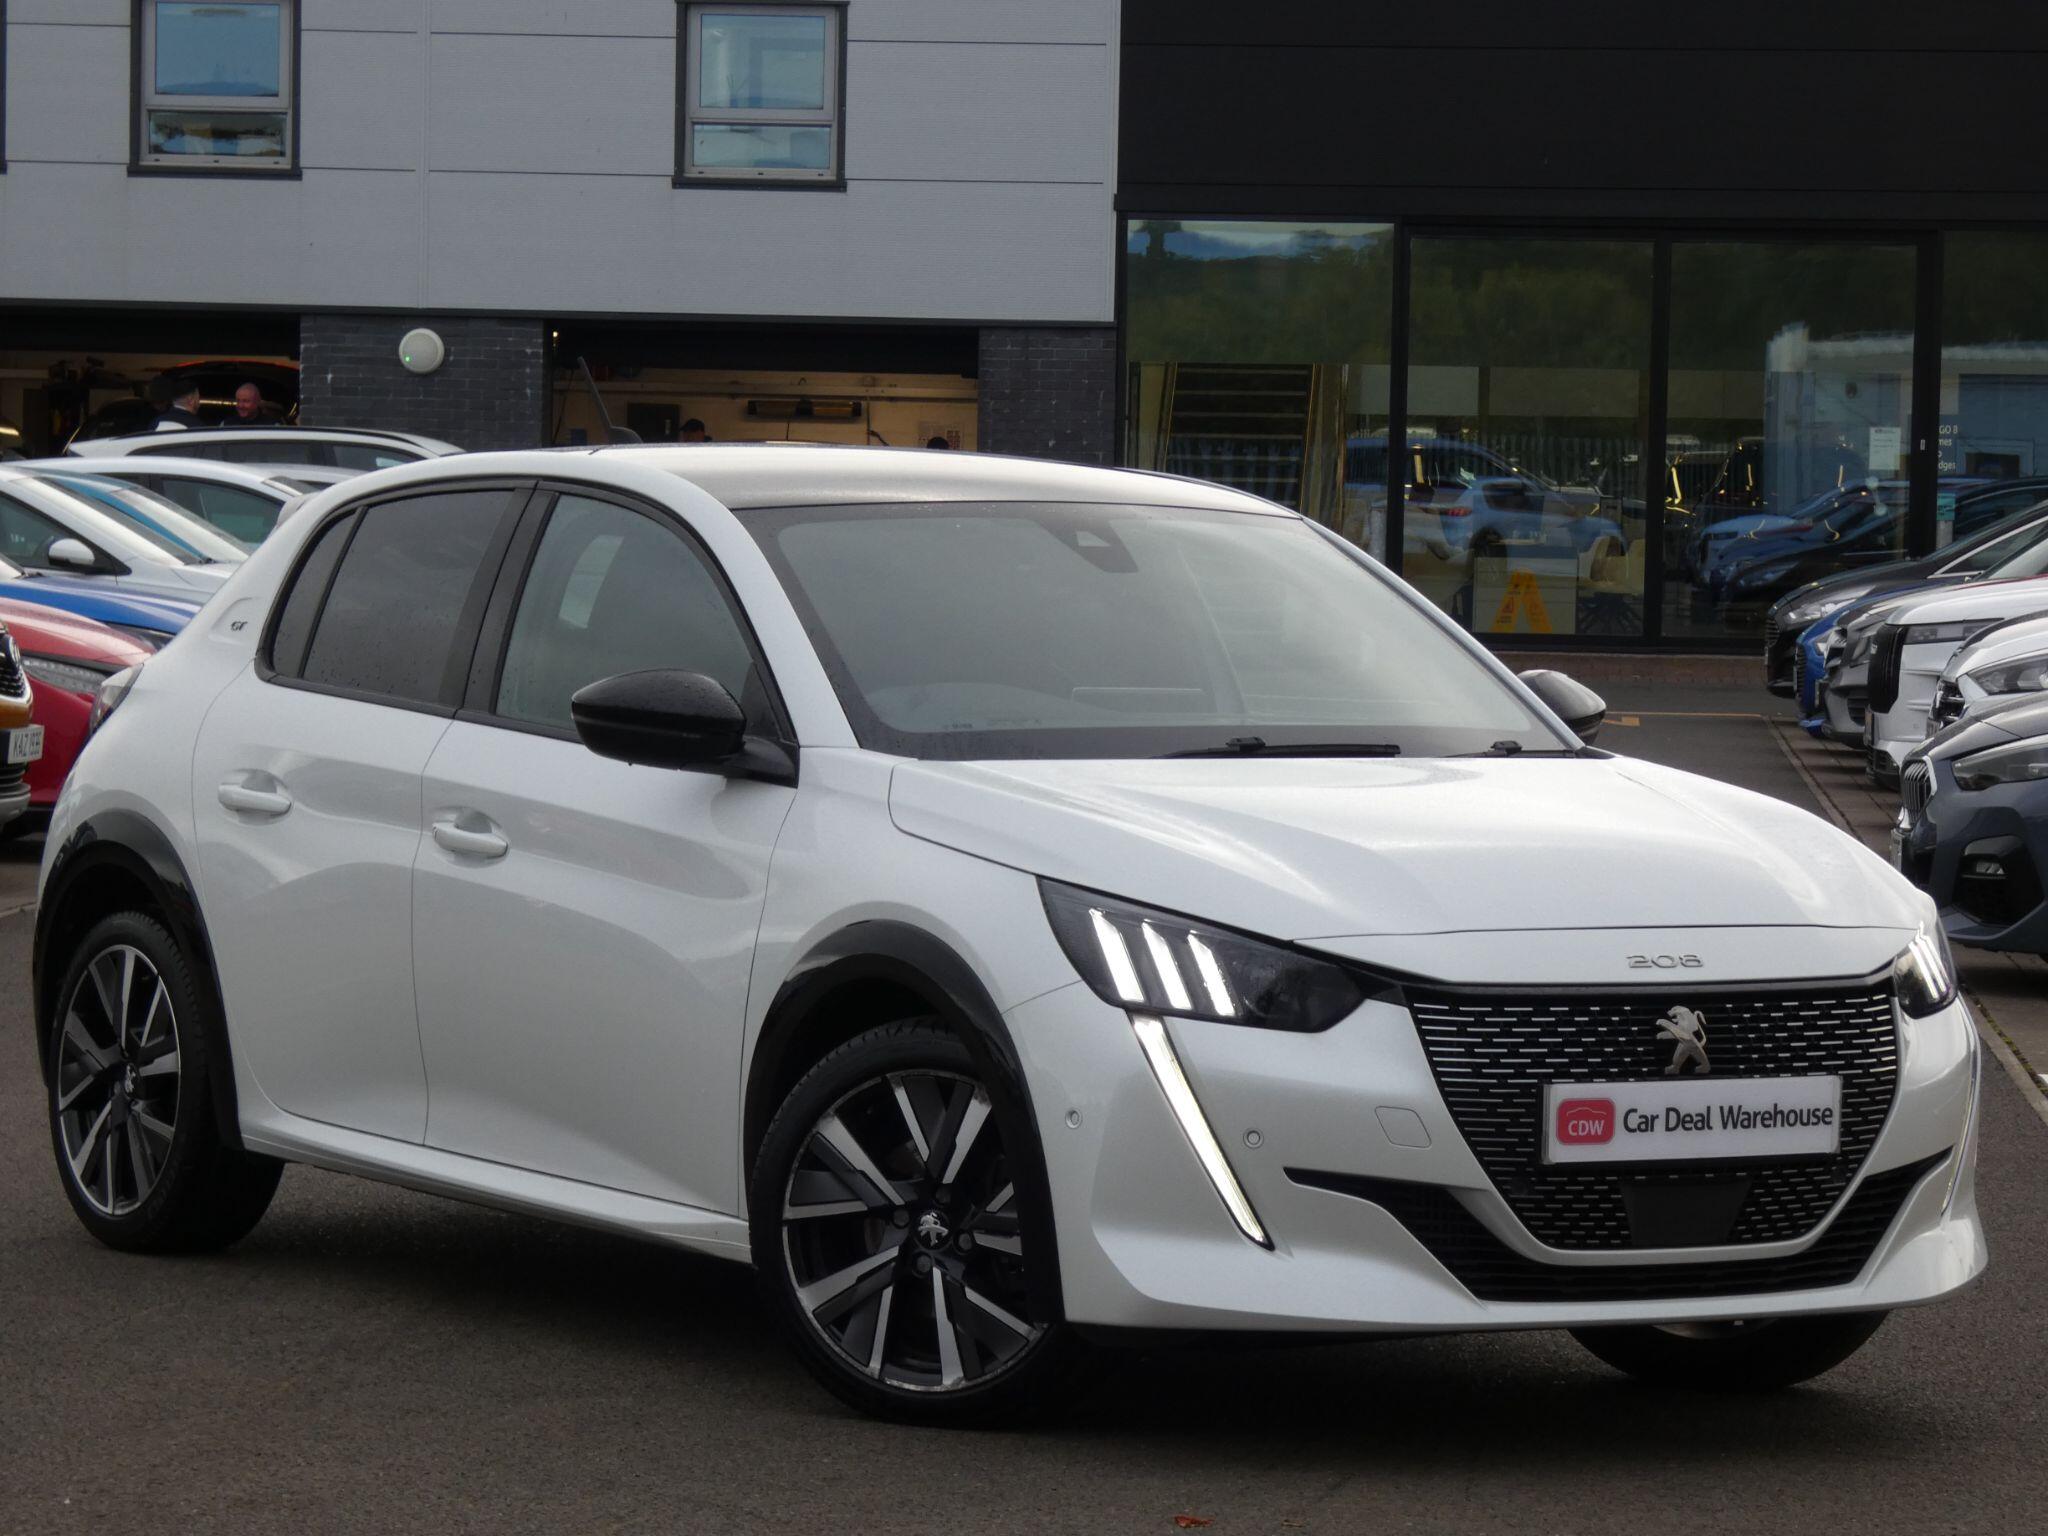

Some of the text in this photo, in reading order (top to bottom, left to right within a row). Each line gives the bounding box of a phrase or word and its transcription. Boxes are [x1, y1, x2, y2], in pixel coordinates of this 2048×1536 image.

[1625, 954, 1704, 969] 208
[1623, 1103, 1833, 1134] Car Deal Warehouse
[1567, 1119, 1605, 1137] CDW
